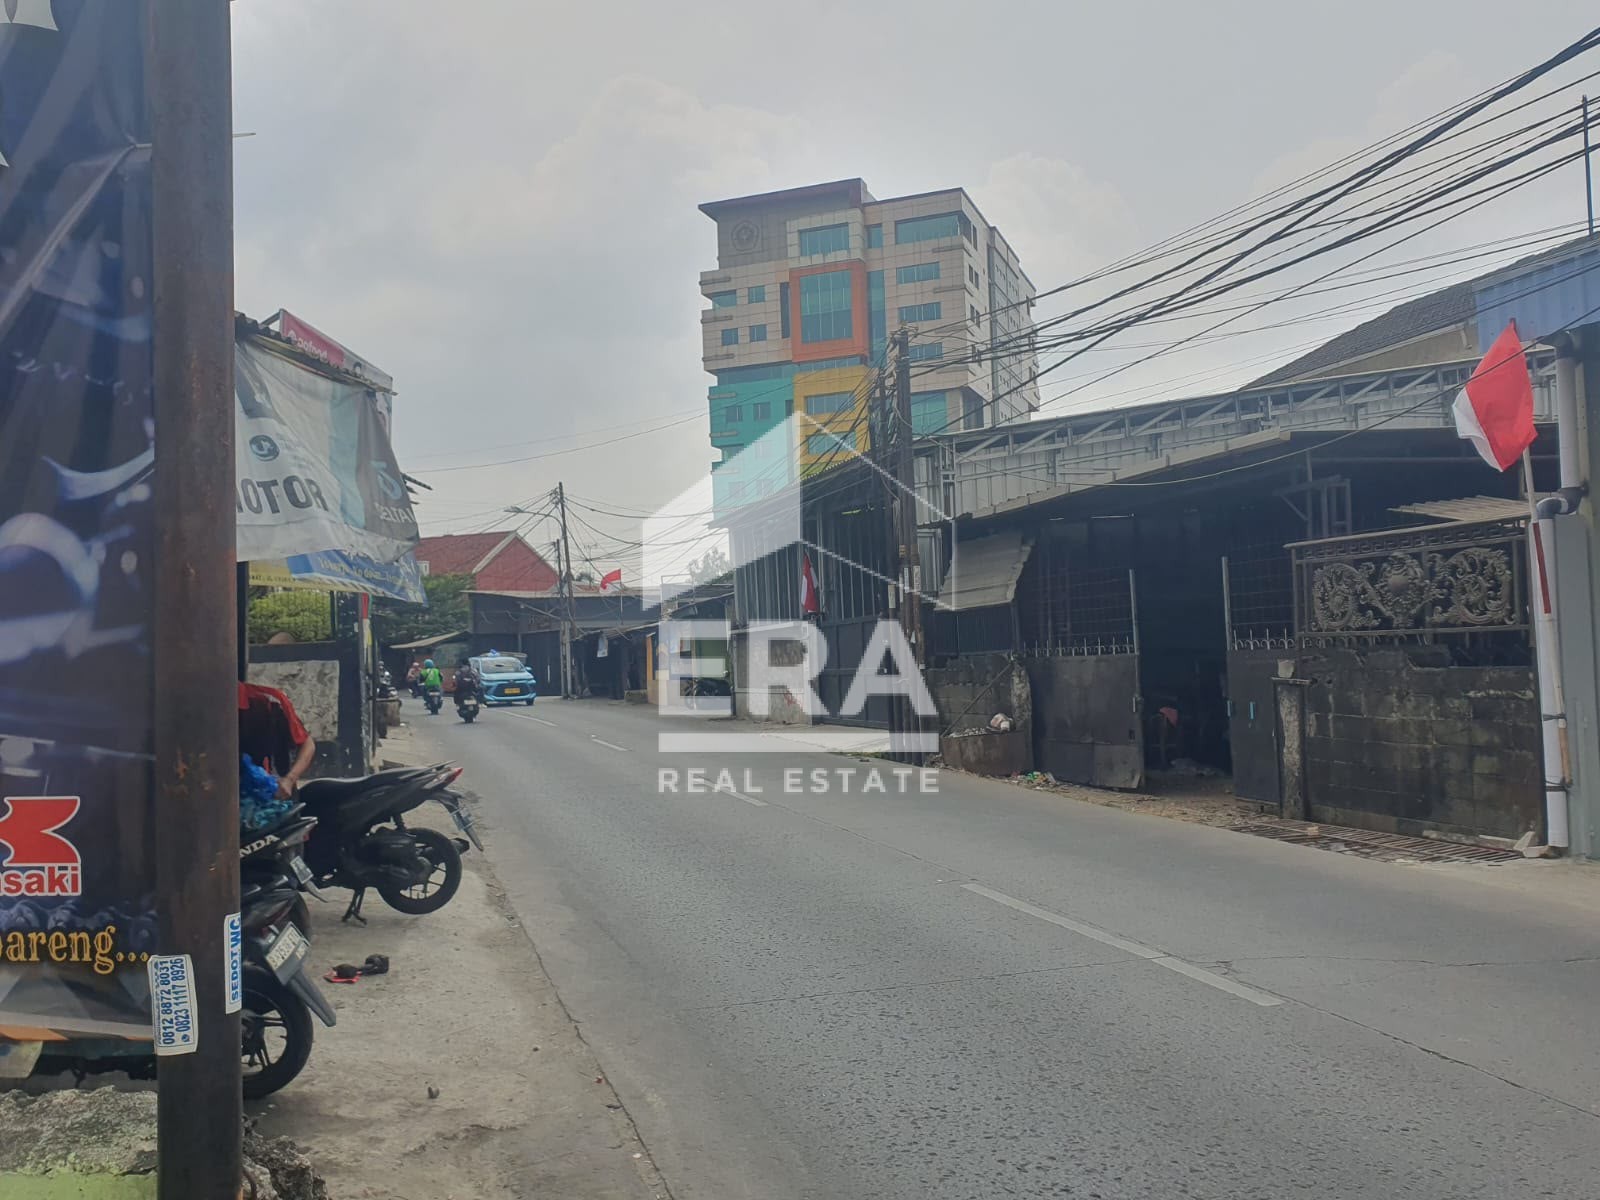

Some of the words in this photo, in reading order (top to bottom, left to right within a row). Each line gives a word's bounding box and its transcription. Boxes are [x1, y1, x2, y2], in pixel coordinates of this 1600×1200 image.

[0, 865, 81, 895] saki
[0, 925, 149, 975] areng...
[159, 960, 171, 986] 8031
[170, 958, 186, 981] 8926
[230, 950, 239, 1001] SEDOT
[160, 988, 173, 1015] 8872
[172, 985, 188, 1006] 1117
[162, 1017, 175, 1045] 0812
[174, 1008, 191, 1032] 0823
